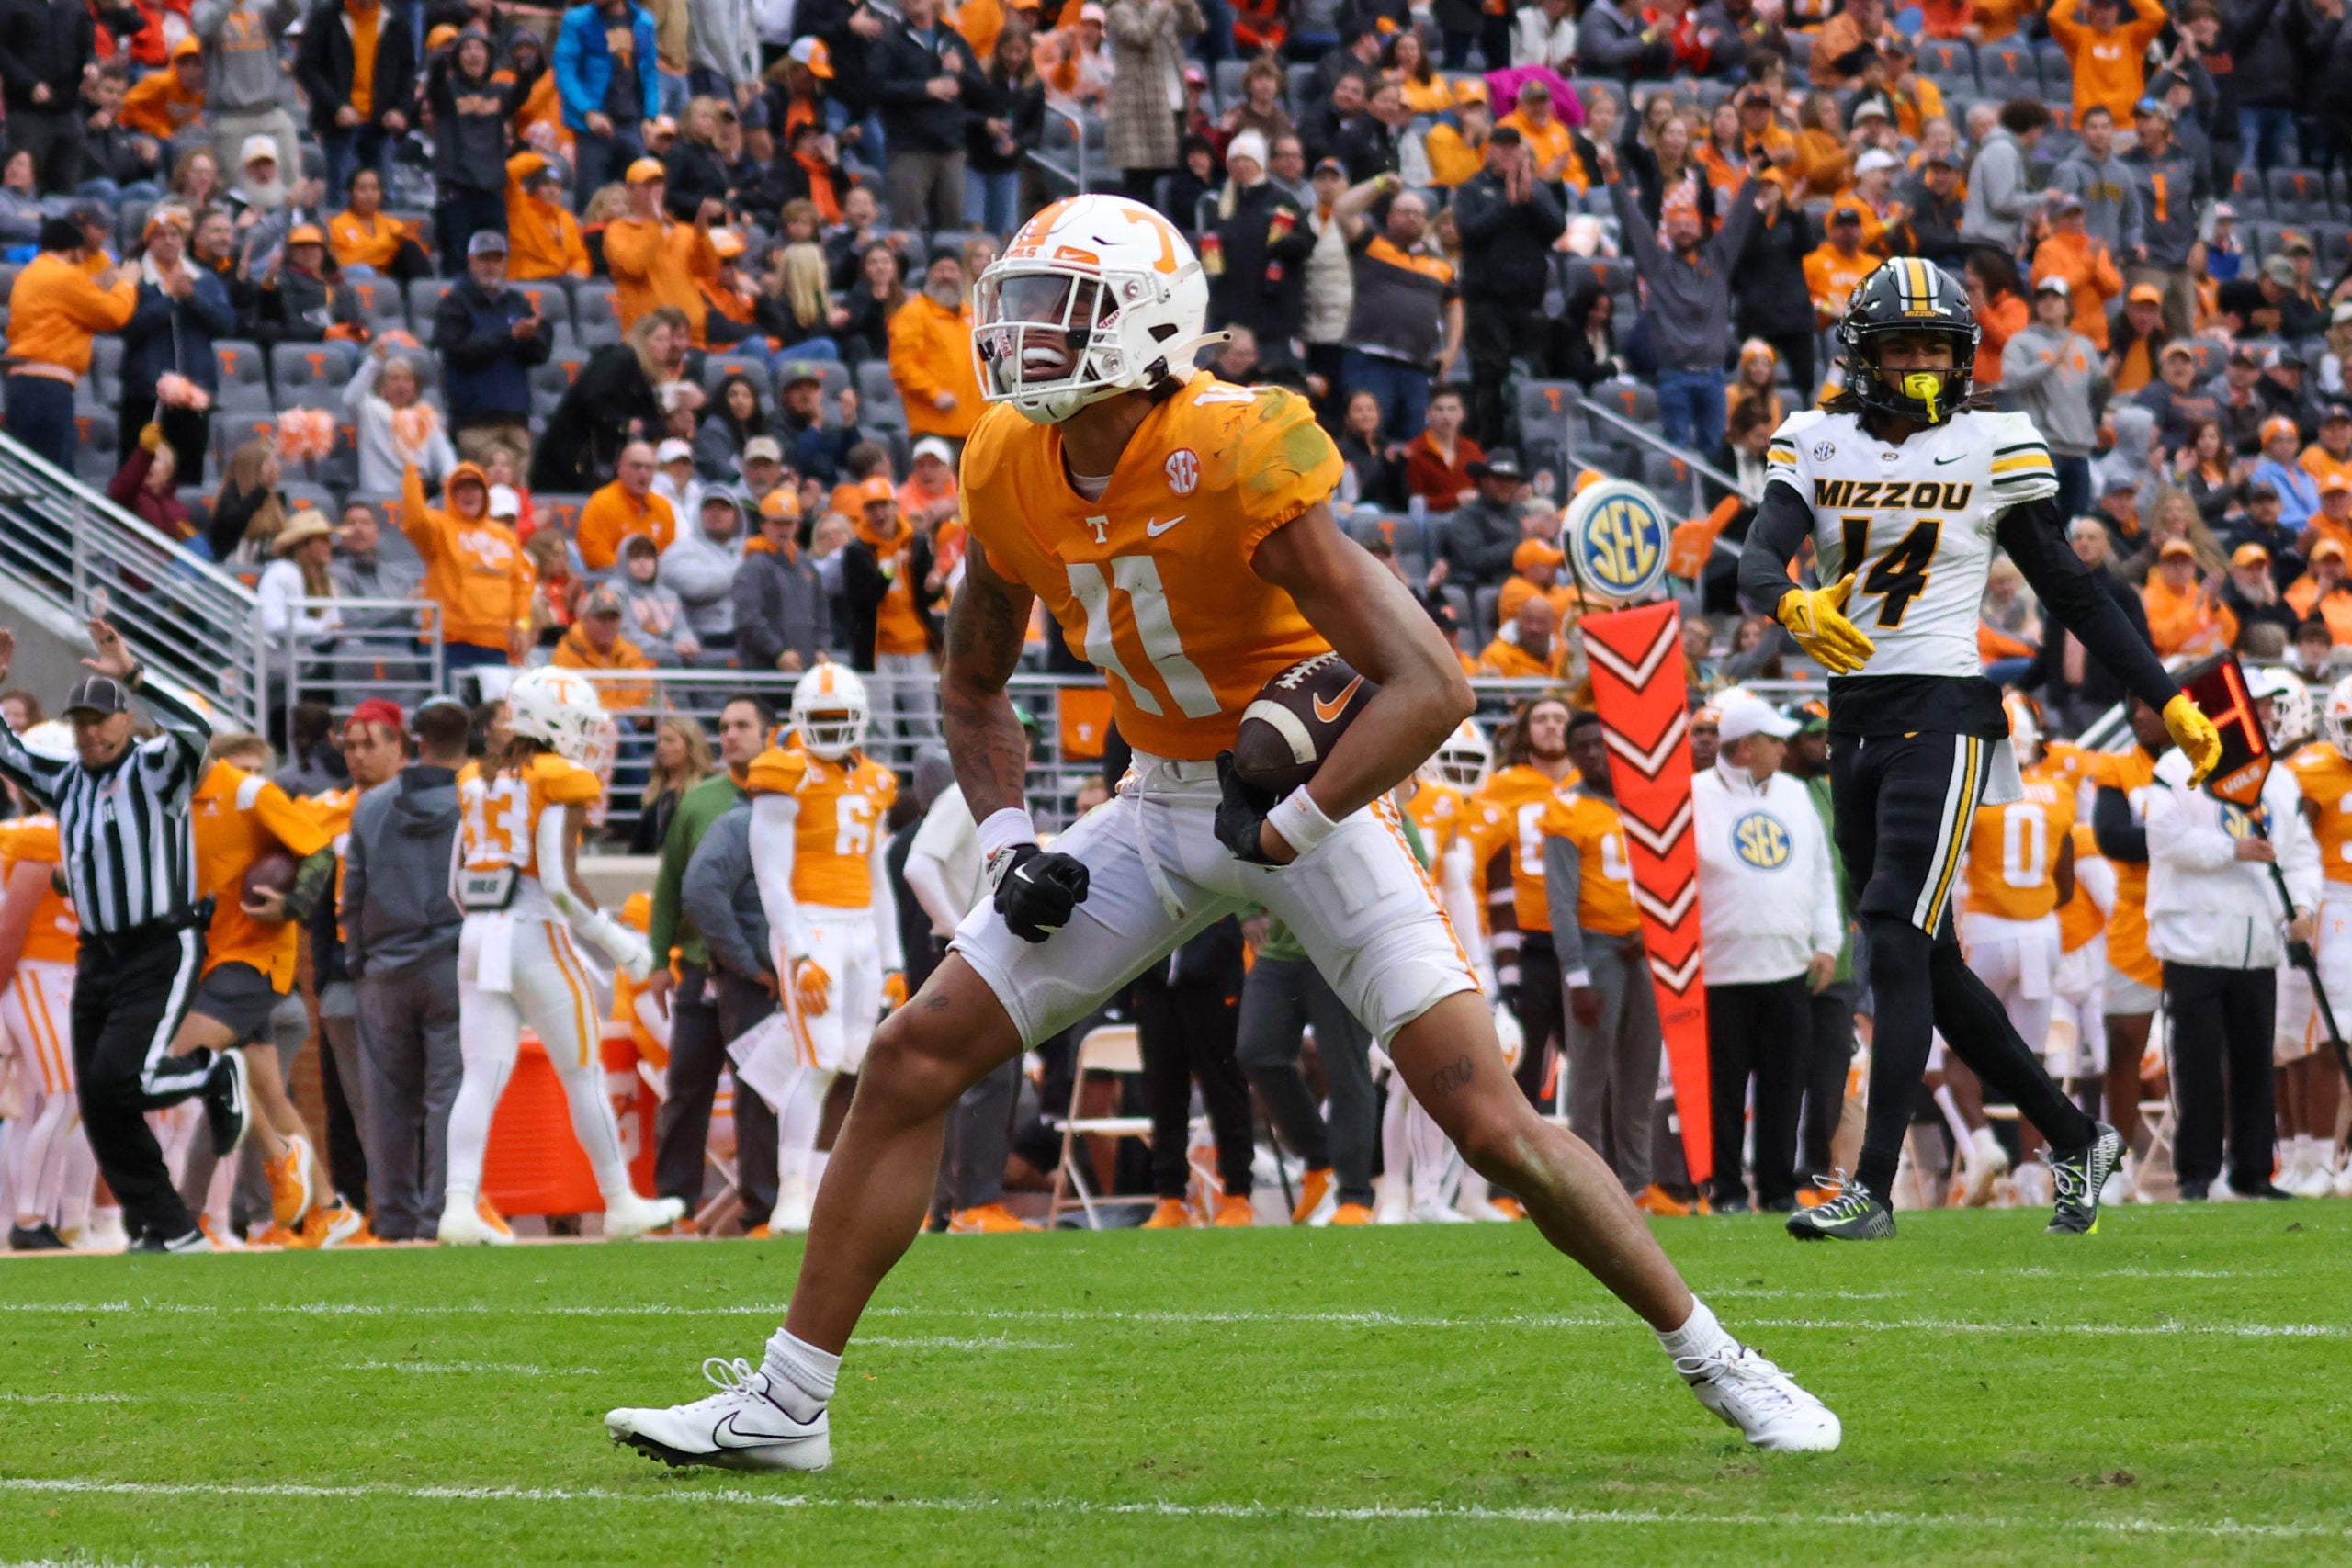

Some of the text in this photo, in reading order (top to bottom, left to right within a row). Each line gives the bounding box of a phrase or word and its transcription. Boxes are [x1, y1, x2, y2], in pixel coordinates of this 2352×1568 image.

[1120, 208, 1189, 276] T
[1165, 450, 1199, 493] SEC
[1815, 442, 1835, 460] SEC
[1813, 478, 1973, 512] MIZZOU
[1086, 515, 1109, 544] T
[1588, 500, 1657, 585] SEC
[1838, 515, 1943, 630] 14
[1066, 555, 1223, 719] 11
[546, 677, 576, 705] T
[2222, 765, 2262, 794] VOLS
[835, 793, 869, 855] 6
[1737, 814, 1788, 866] SEC
[2004, 803, 2046, 888] 0
